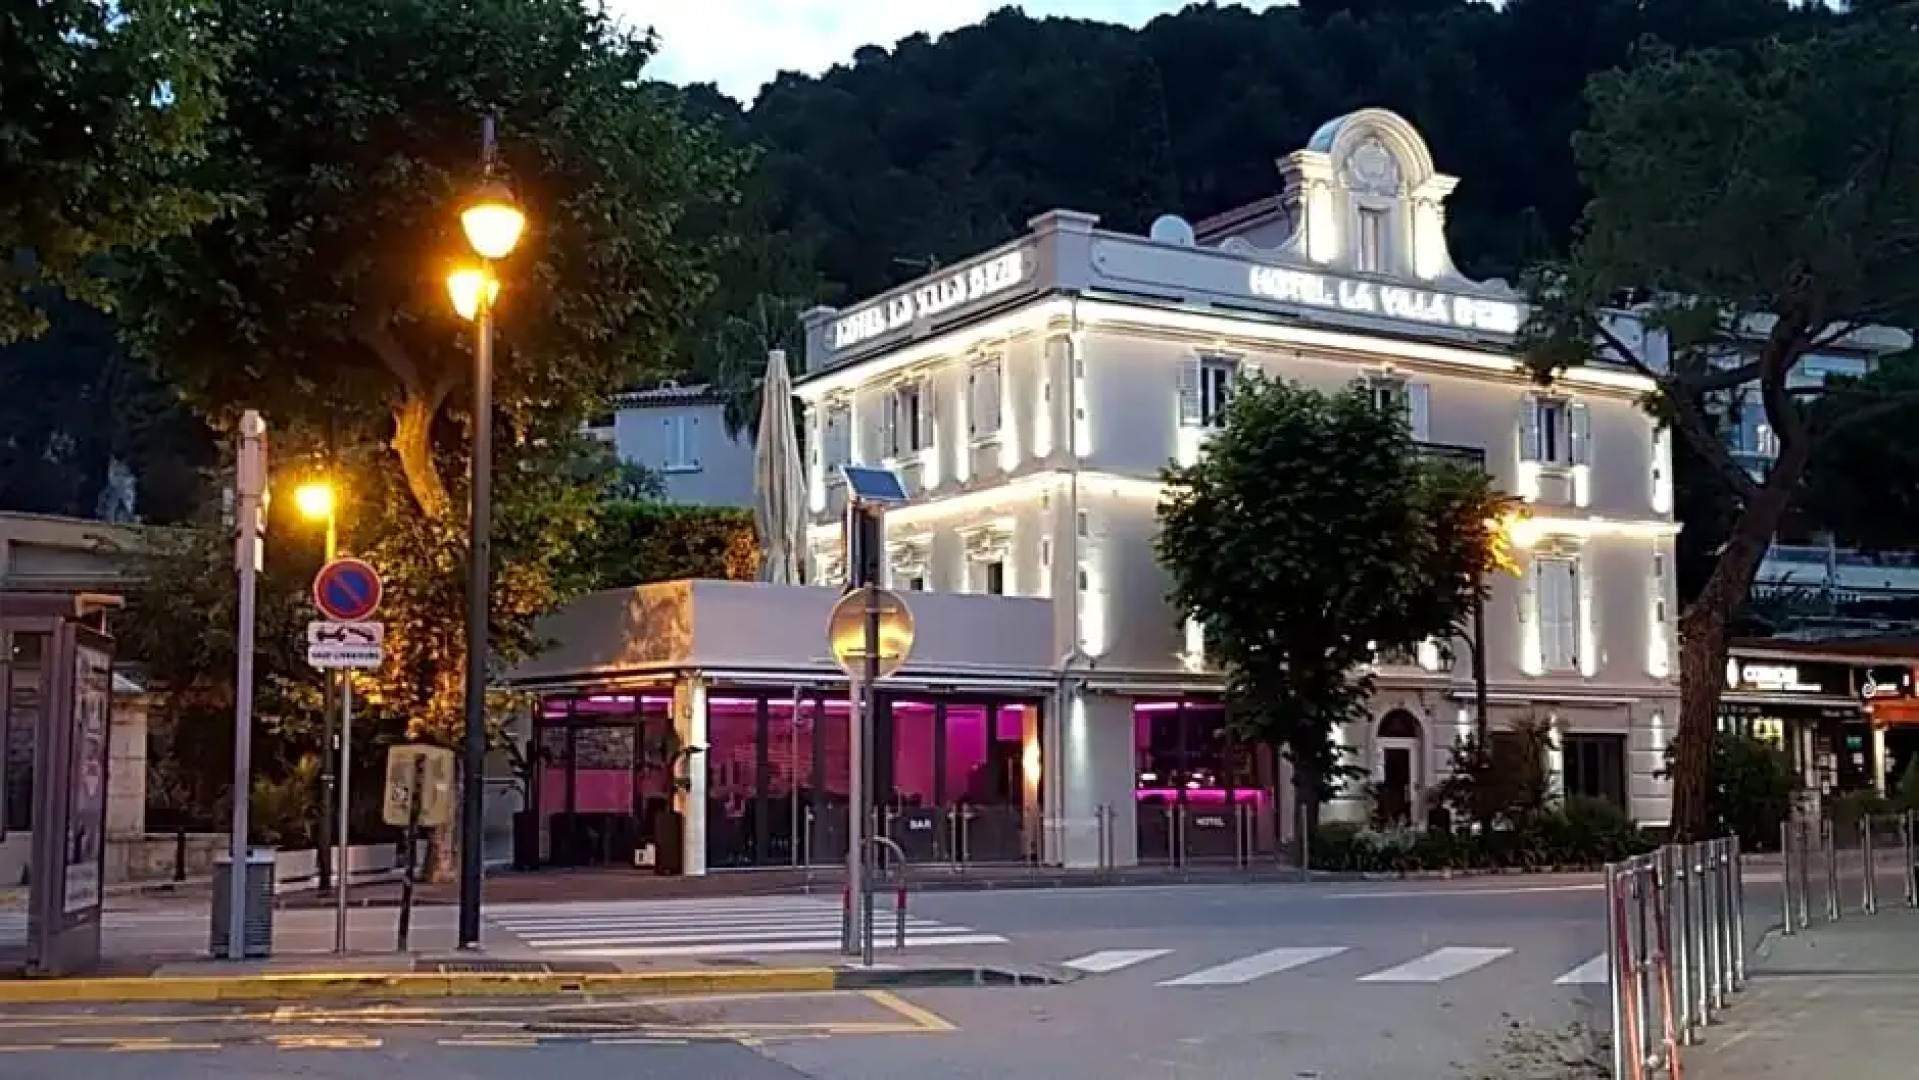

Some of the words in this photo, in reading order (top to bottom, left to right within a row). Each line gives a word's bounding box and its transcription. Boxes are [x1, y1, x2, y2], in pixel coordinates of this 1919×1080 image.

[834, 305, 887, 348] HOTEL
[889, 294, 914, 328] LA
[916, 274, 966, 318] VILLA
[1249, 264, 1336, 307] HOTEL
[1338, 279, 1377, 311] LA
[1379, 285, 1449, 325] VILLA
[909, 818, 932, 830] BAR
[1195, 816, 1226, 828] HOTEL
